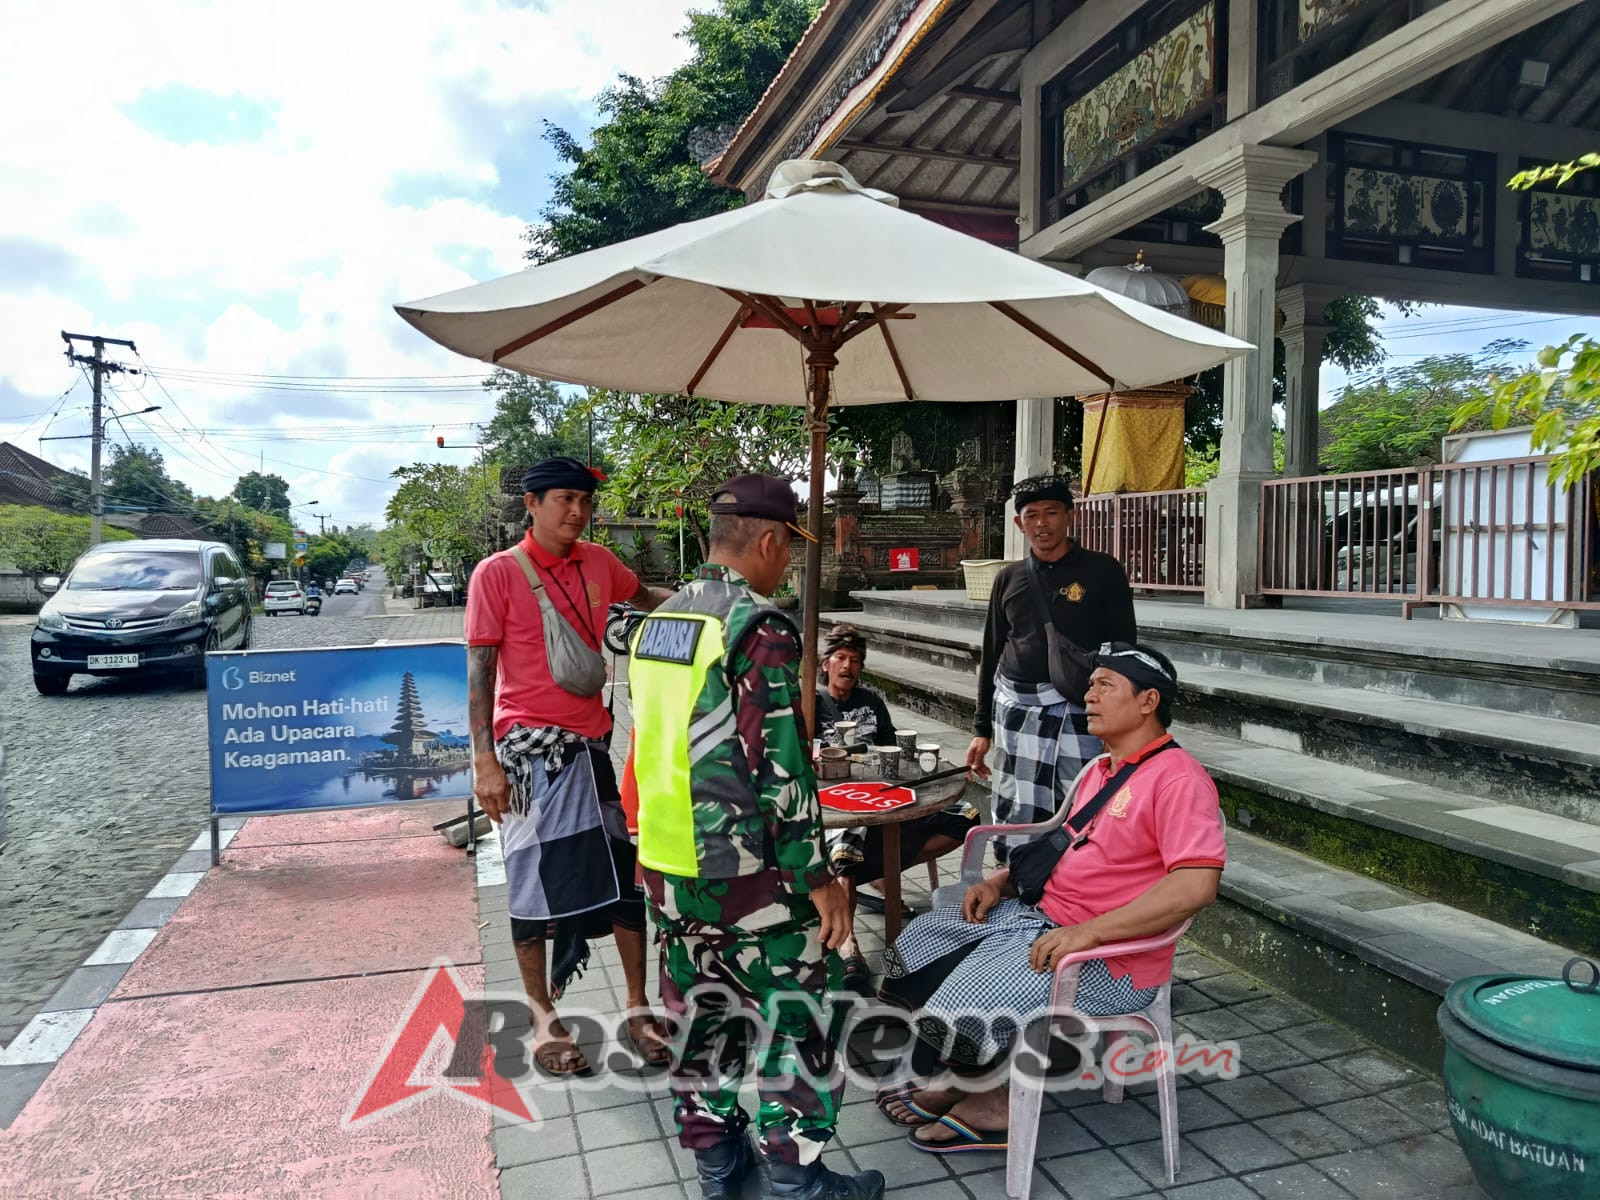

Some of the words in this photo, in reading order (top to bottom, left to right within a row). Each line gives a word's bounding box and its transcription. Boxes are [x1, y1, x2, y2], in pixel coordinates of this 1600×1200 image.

[89, 656, 100, 665] DK
[103, 655, 124, 664] 1123
[249, 669, 297, 684] Biznet
[222, 702, 297, 721] Mohon
[302, 695, 388, 717] Hati-hati
[223, 726, 265, 745] Ada
[271, 724, 355, 745] Upacara
[224, 748, 351, 770] Keagamaan.
[829, 788, 902, 808] STOP
[1484, 981, 1548, 1006] BATUAN
[1470, 1118, 1506, 1151] ADAT
[1509, 1136, 1585, 1173] BATUAN
